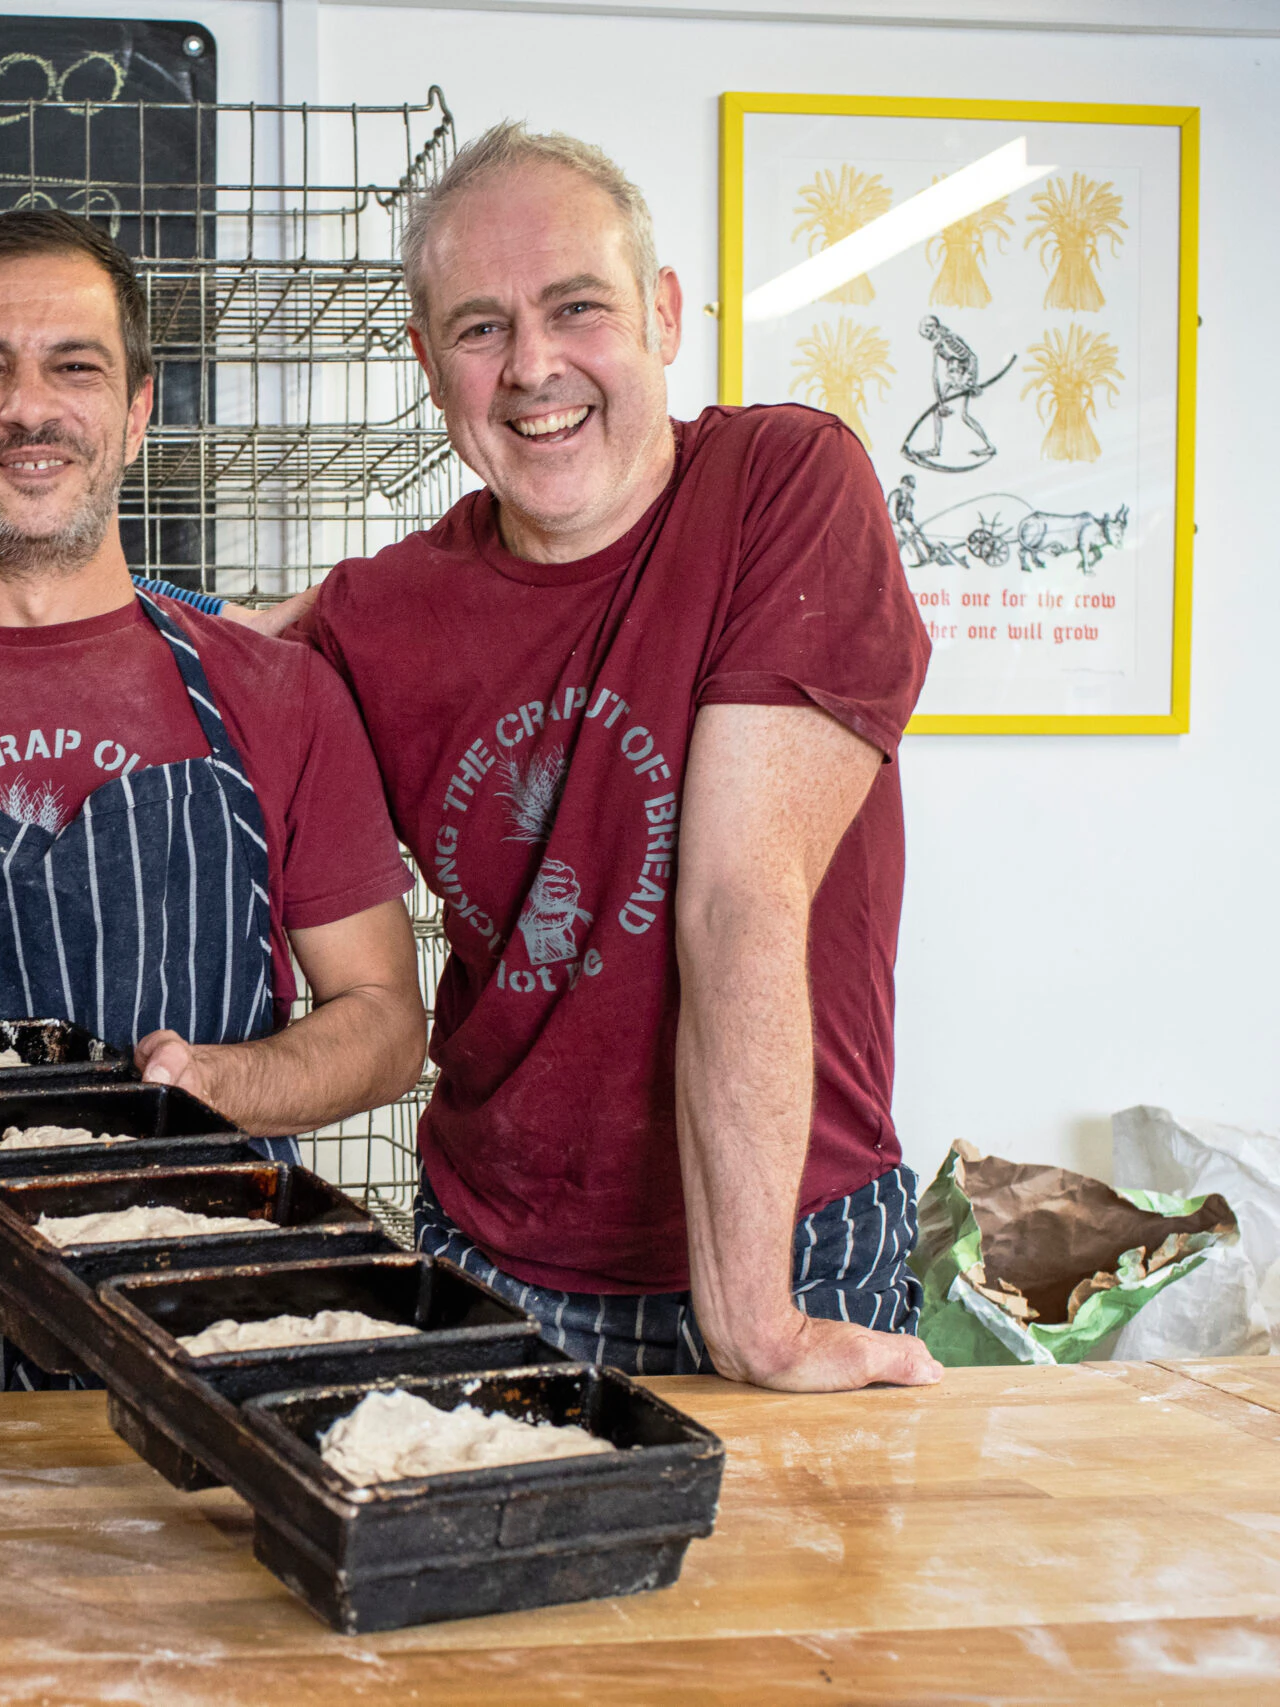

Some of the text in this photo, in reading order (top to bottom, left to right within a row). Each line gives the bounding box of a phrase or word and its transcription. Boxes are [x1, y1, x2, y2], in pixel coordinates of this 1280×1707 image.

[961, 591, 991, 607] one
[1002, 588, 1026, 607] for
[1037, 589, 1064, 610] the
[1074, 591, 1117, 609] crow
[967, 623, 998, 640] one
[1008, 621, 1043, 640] will
[1053, 623, 1099, 644] grow
[441, 738, 496, 813] THE
[620, 726, 672, 783] OF
[618, 792, 678, 935] BREAD
